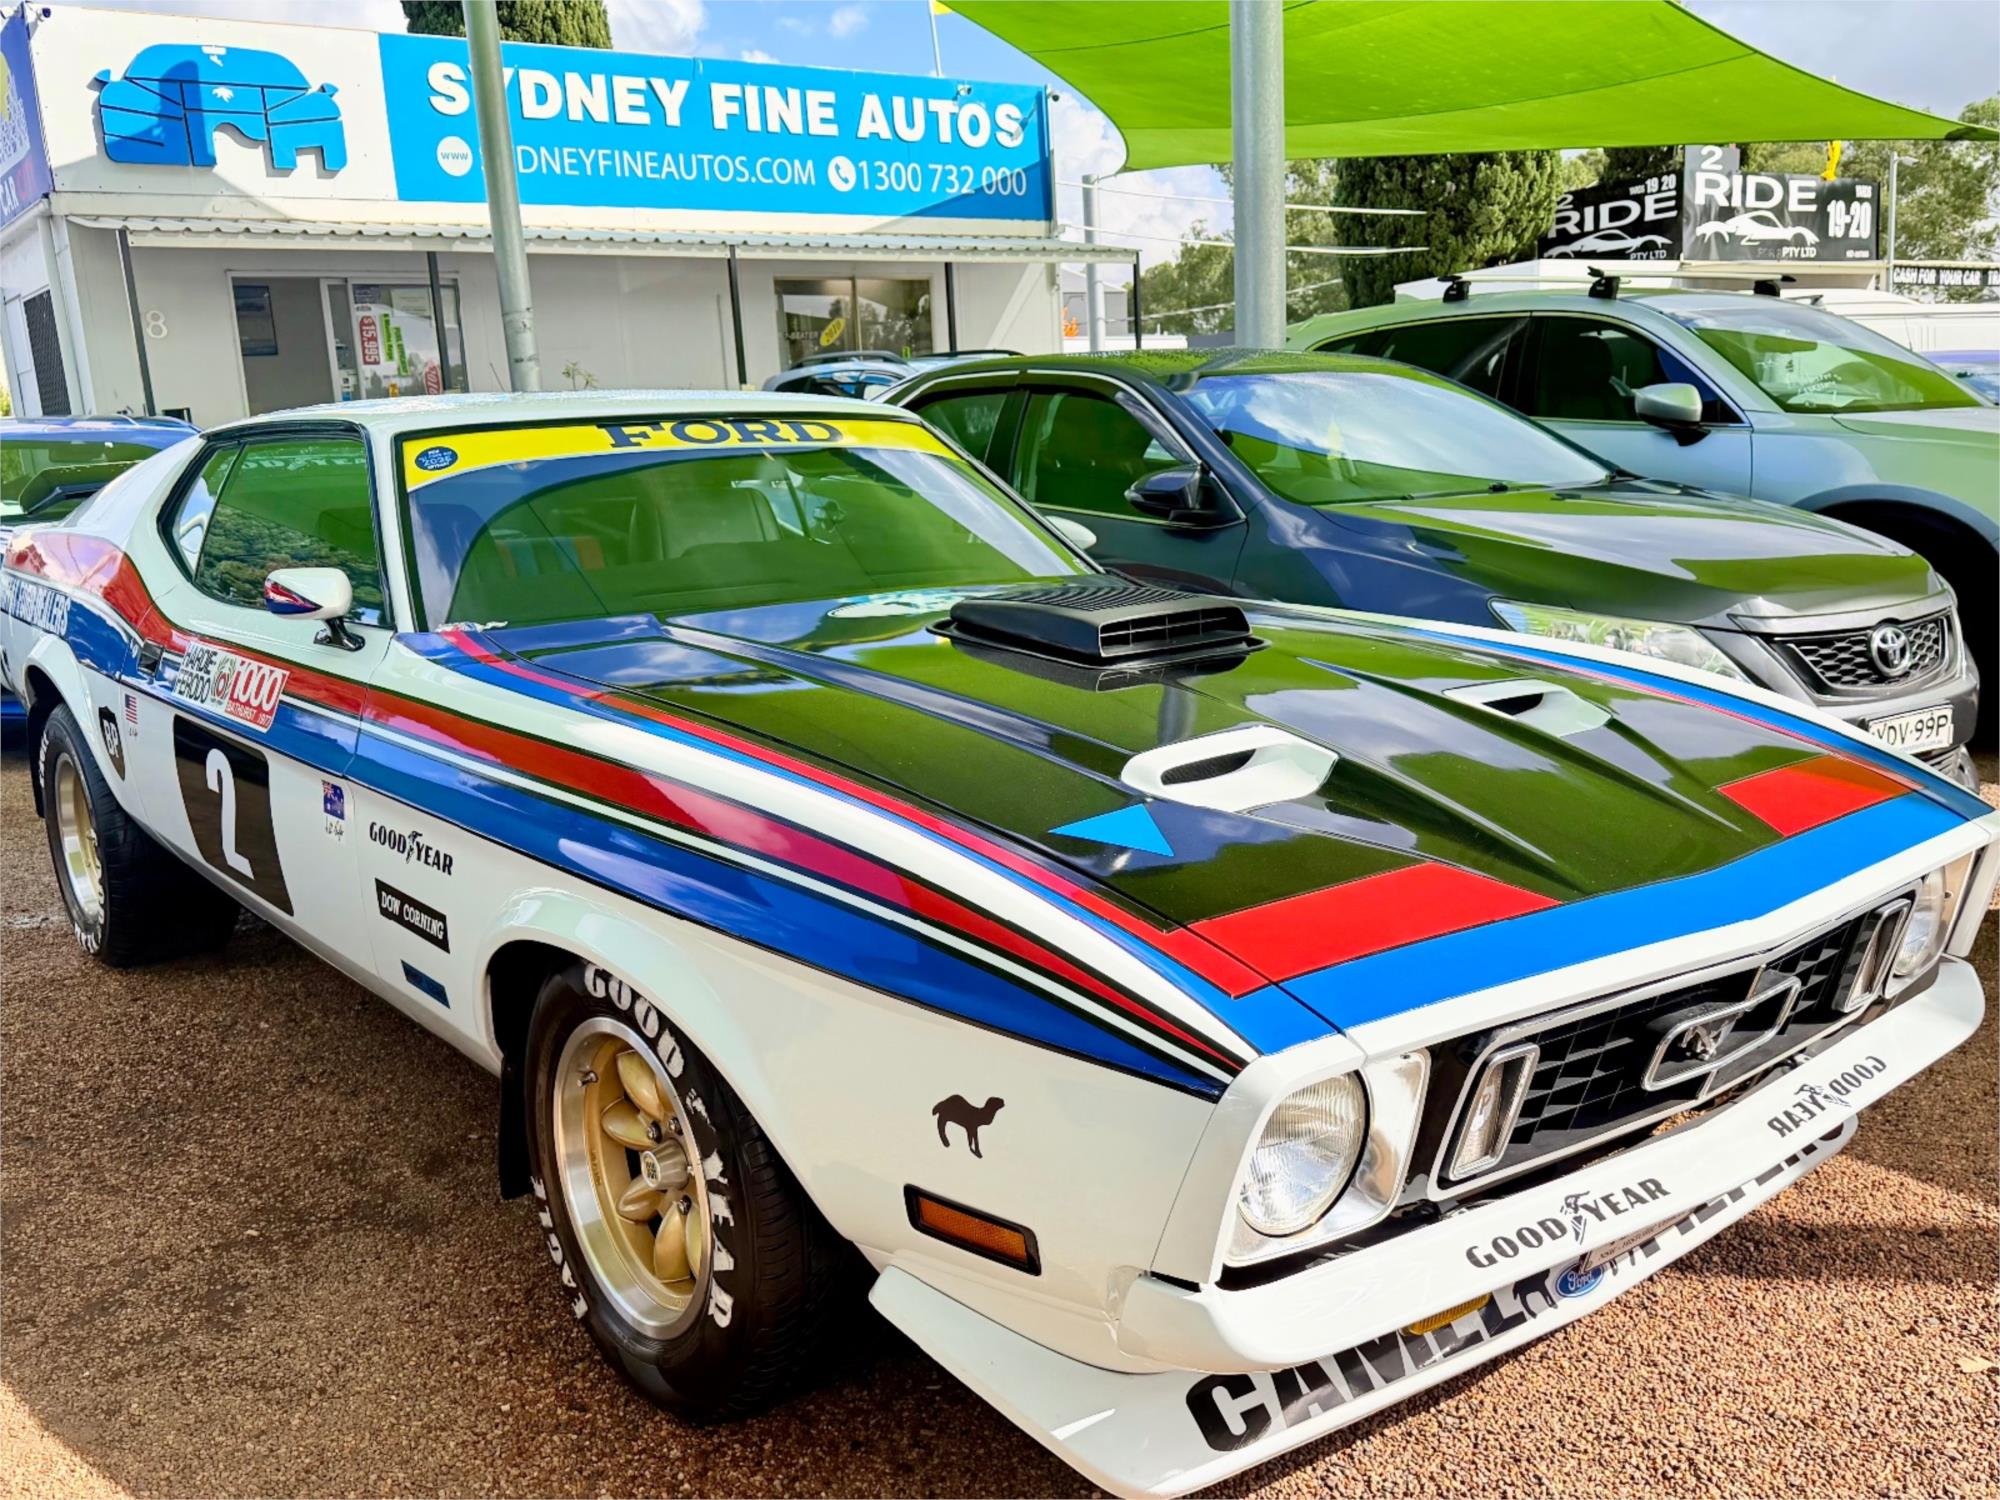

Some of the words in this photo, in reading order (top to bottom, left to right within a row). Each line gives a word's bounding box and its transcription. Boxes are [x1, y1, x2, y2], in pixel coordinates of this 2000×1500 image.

[428, 61, 691, 128] SDNEY
[710, 82, 840, 137] FINE
[857, 95, 1025, 149] AUTOS
[481, 144, 816, 186] DNEYFINEAUTOS.COM
[858, 160, 923, 192] 1300
[928, 164, 976, 195] 732
[981, 167, 1028, 196] 000
[1699, 144, 1724, 171] 2
[1694, 171, 1818, 213] RIDE
[1547, 190, 1679, 240] RIDE
[1826, 199, 1873, 240] 19-20
[1918, 267, 1937, 285] FOR
[145, 309, 168, 339] 8
[597, 419, 844, 449] FORD
[103, 718, 120, 759] BP
[205, 748, 255, 880] 2
[381, 890, 401, 916] DOW
[403, 902, 445, 940] CORNING
[1567, 1270, 1595, 1292] Ford
